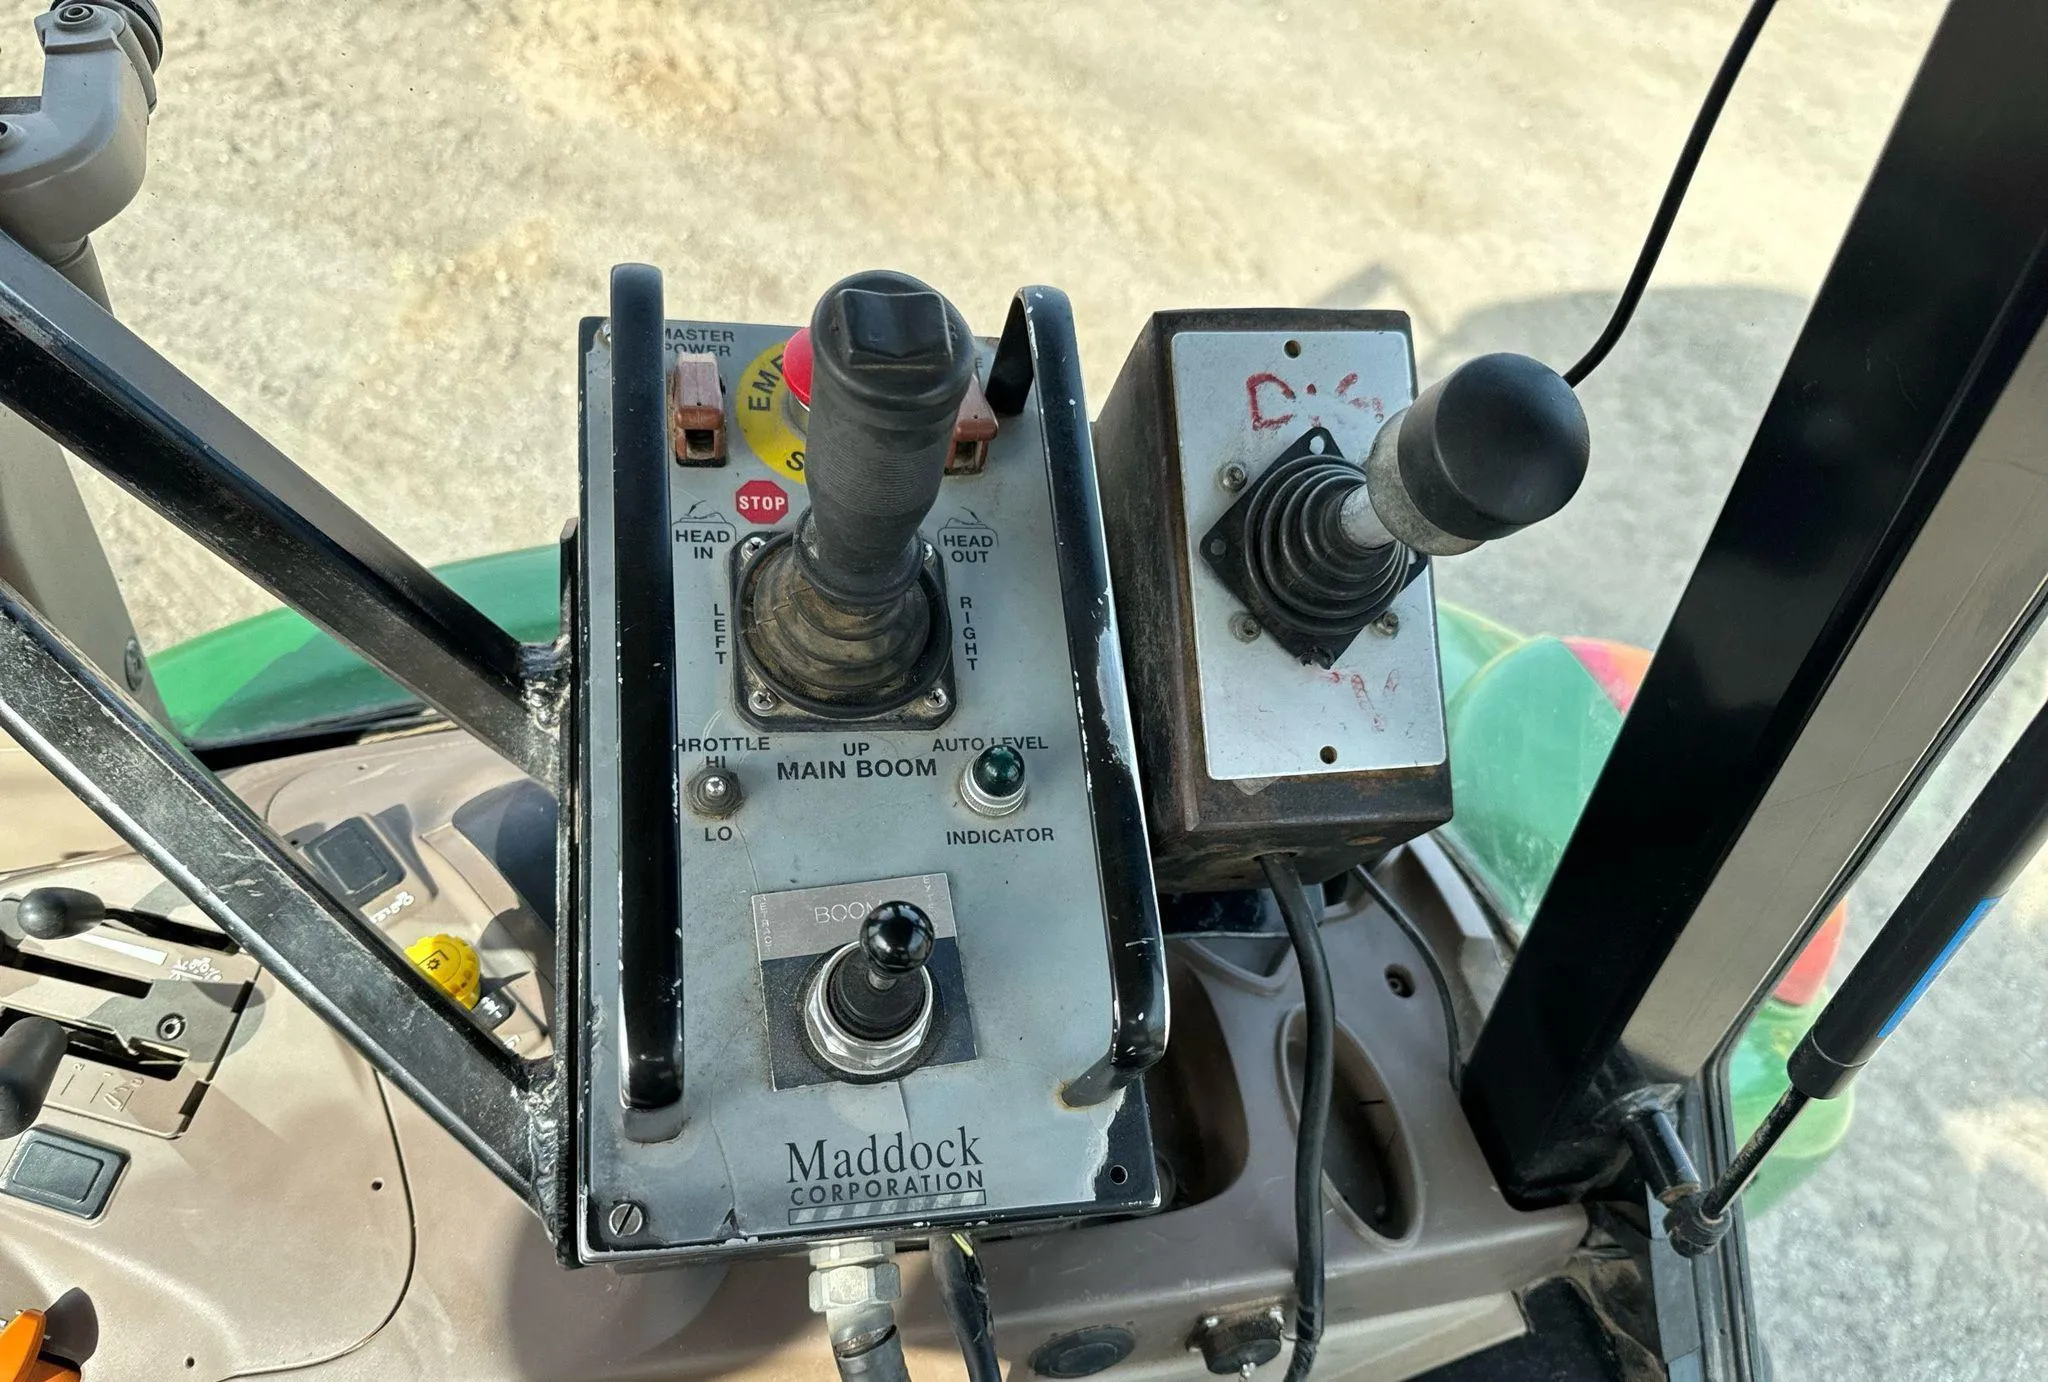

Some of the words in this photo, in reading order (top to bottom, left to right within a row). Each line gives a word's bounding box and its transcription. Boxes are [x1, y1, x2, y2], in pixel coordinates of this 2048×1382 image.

[664, 327, 735, 342] MASTER
[664, 342, 732, 357] POWER
[738, 495, 786, 511] STOP
[675, 529, 731, 543] HEAD
[943, 534, 994, 548] HEAD
[694, 546, 714, 559] IN
[951, 550, 989, 563] OUT
[714, 603, 727, 665] LEFT
[960, 596, 978, 671] RIGHT
[677, 736, 770, 752] HROTTLE
[843, 742, 870, 756] UP
[932, 737, 985, 752] AUTO
[705, 755, 726, 769] HI
[777, 760, 847, 781] MAIN
[856, 758, 938, 778] BOOM
[705, 826, 733, 842] LO
[946, 827, 1055, 846] INDICATOR
[785, 1126, 984, 1183] Maddock
[790, 1169, 983, 1206] CORPORATION
